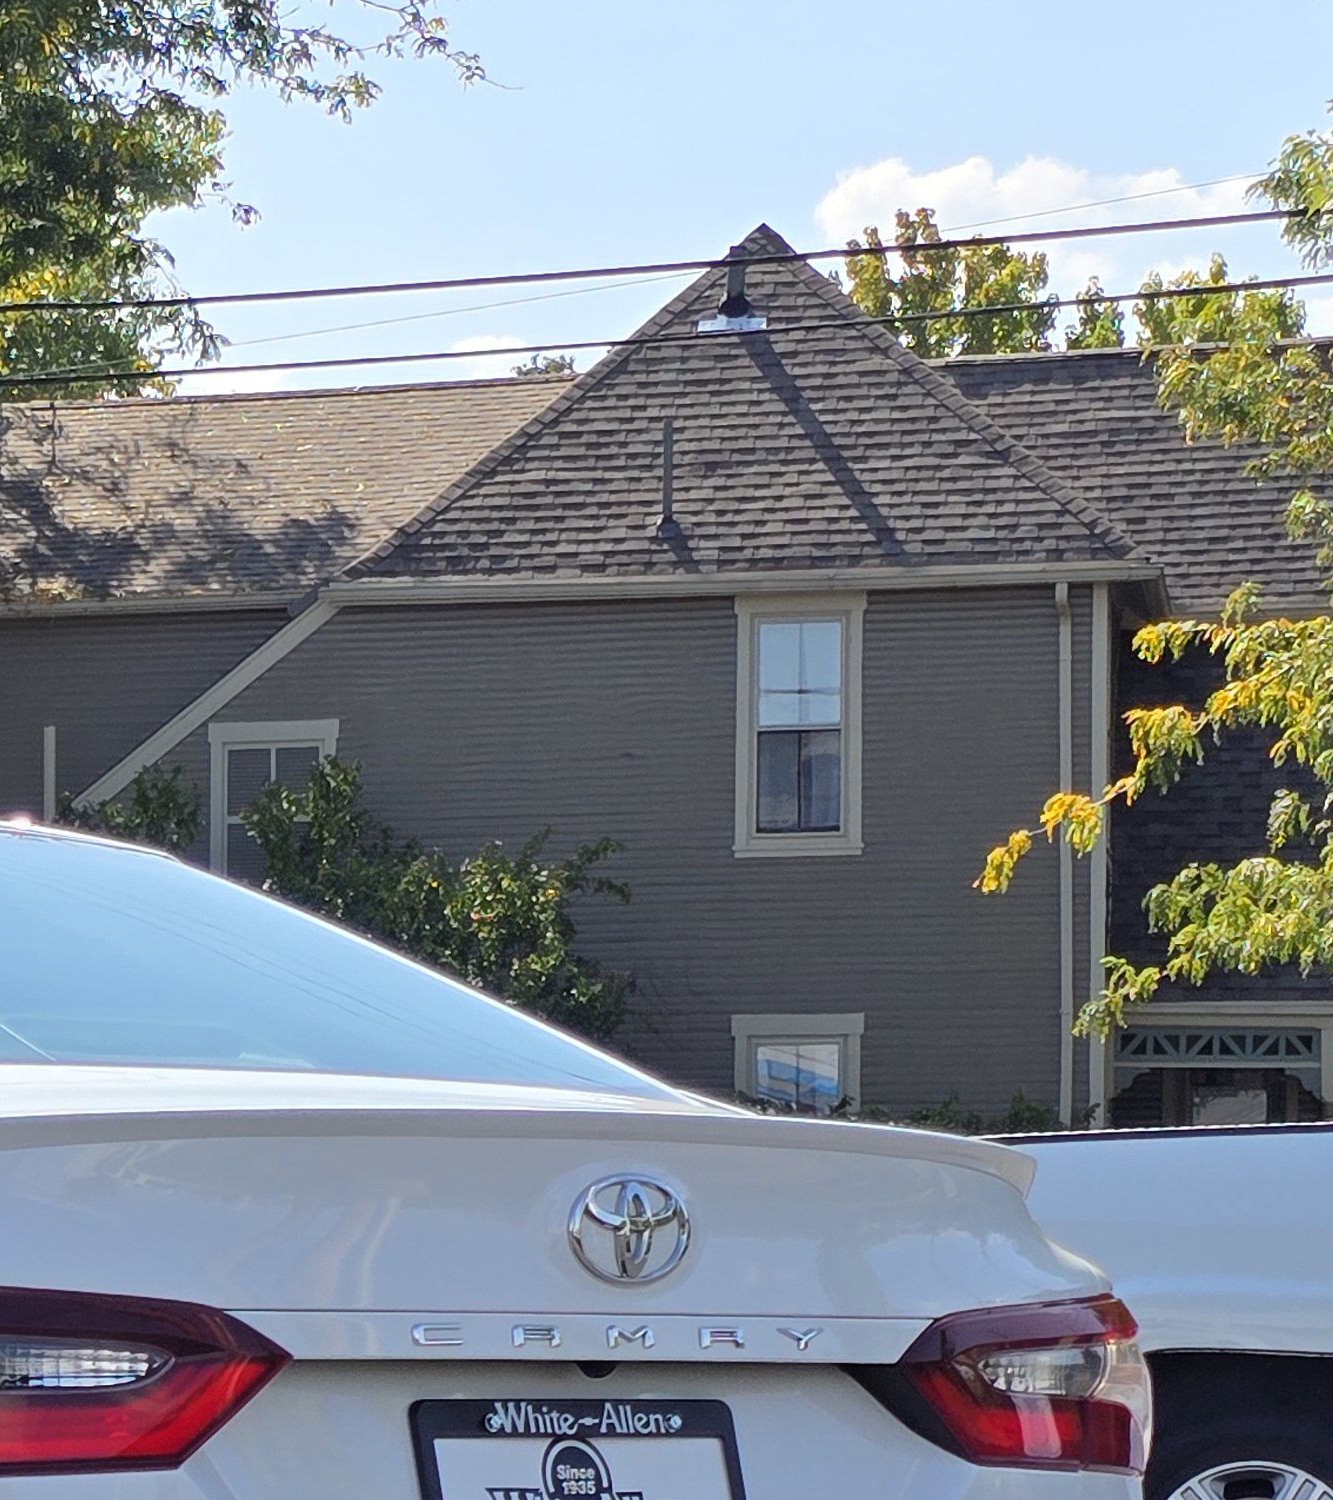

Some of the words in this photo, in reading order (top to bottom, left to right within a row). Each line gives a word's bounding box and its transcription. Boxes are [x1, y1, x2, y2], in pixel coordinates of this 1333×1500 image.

[410, 1322, 824, 1350] CAMRY
[556, 1464, 596, 1481] Since
[562, 1481, 597, 1496] 1935
